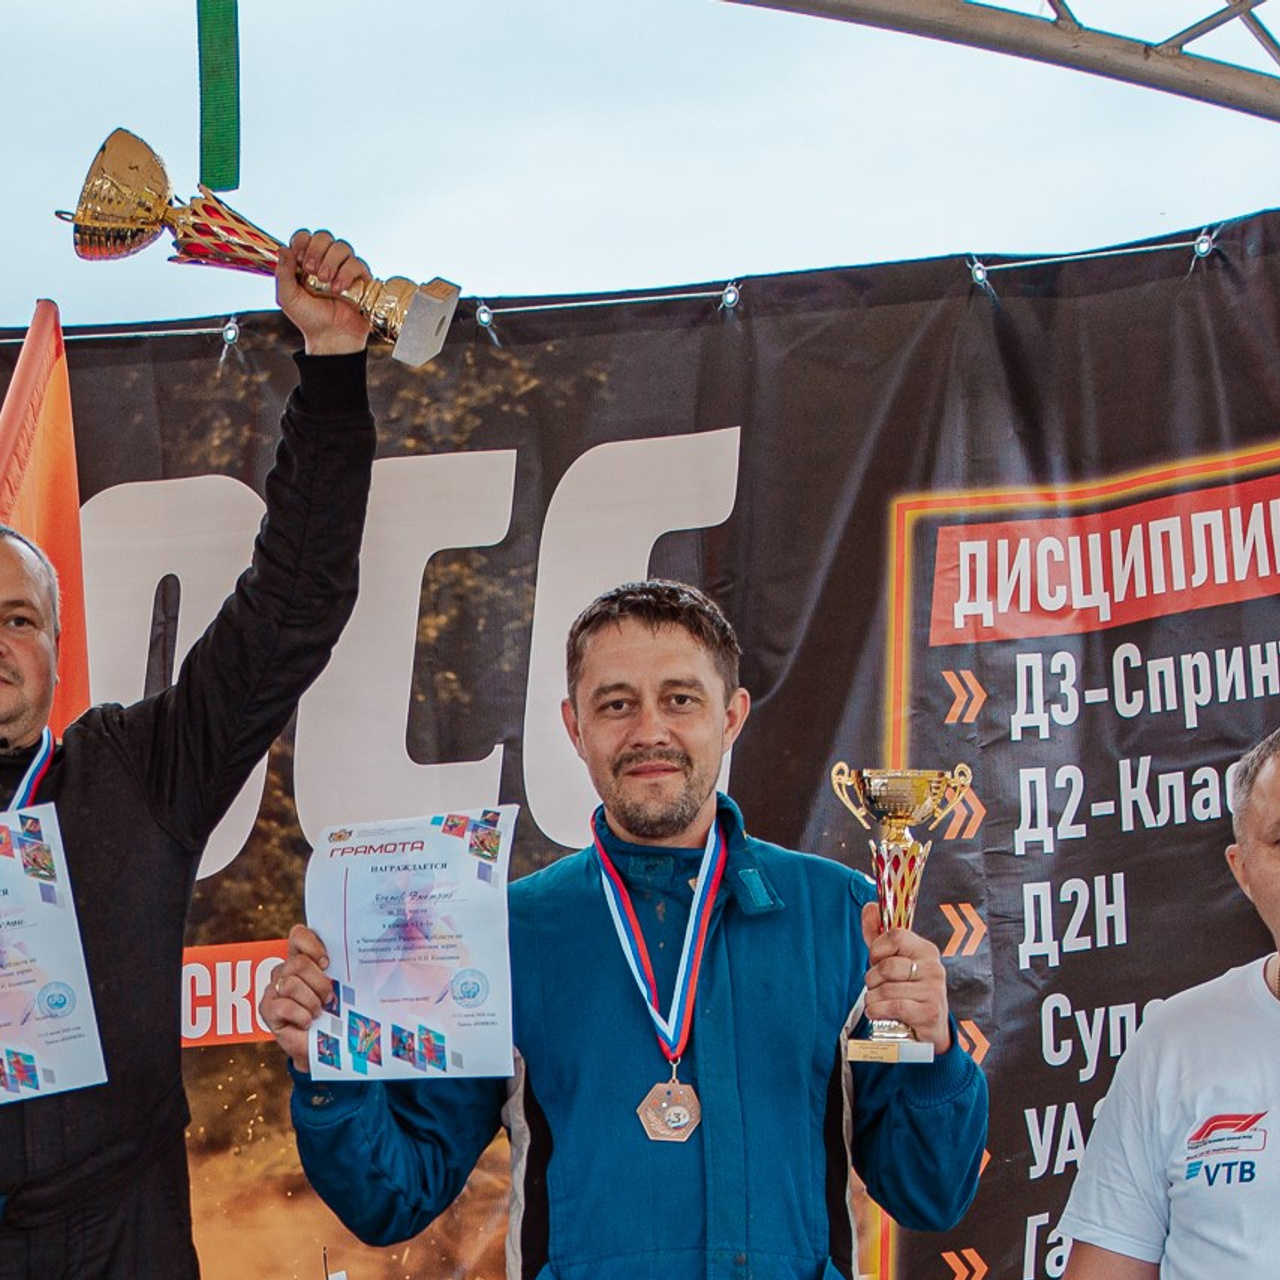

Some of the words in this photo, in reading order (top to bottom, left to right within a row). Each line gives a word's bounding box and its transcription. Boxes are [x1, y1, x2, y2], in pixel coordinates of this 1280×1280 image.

[953, 498, 1280, 629] ДИСЦИПЛИ
[1010, 638, 1280, 741] Д3-Сприн
[330, 841, 425, 858] ГРАМОТА
[371, 862, 448, 874] НАГРАЖДАЕТСЯ
[1019, 872, 1127, 969] Д2Н
[1041, 993, 1165, 1083] Суп
[1024, 1097, 1104, 1180] УА
[1204, 1160, 1256, 1187] VTB
